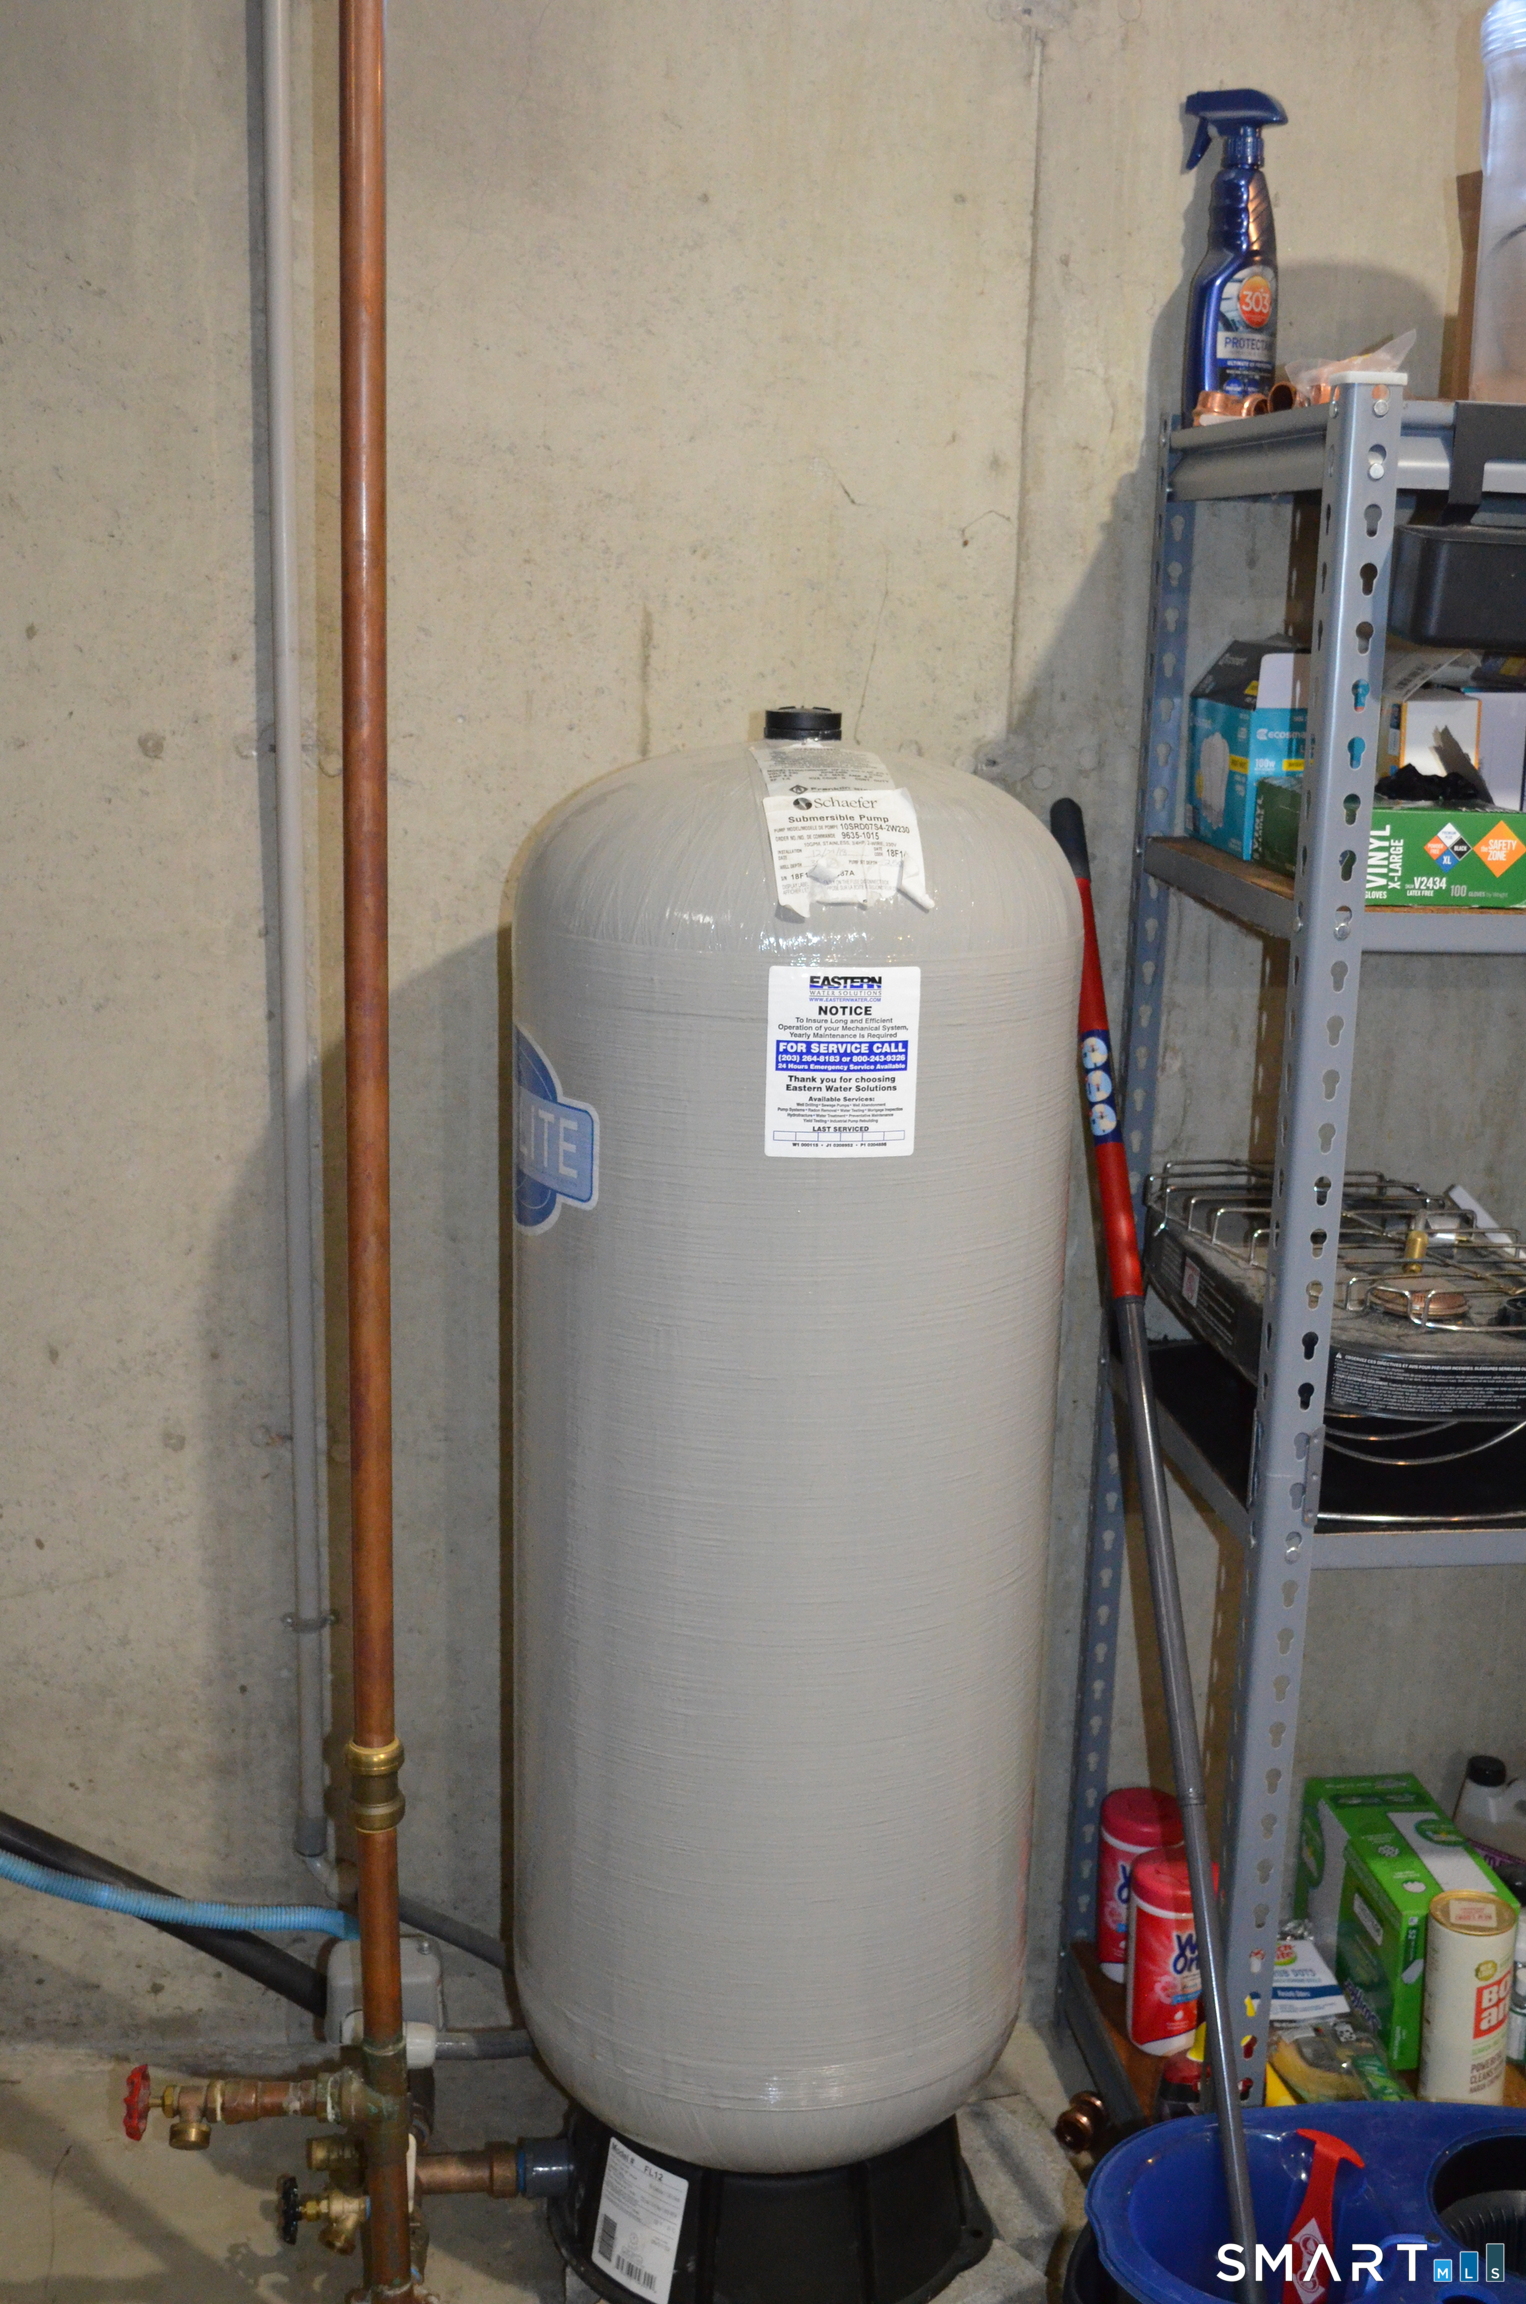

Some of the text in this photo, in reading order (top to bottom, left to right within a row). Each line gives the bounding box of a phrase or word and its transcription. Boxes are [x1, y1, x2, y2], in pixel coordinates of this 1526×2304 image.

[1242, 291, 1271, 313] 303
[814, 797, 878, 809] Schaefer
[788, 814, 889, 823] Submersible Pump
[841, 832, 880, 840] 9635-1015
[1488, 840, 1517, 851] SAFETY
[1366, 824, 1391, 889] VINYL
[1443, 856, 1452, 865] XL
[1488, 851, 1507, 861] ZONE
[1388, 839, 1404, 889] X-LARGE
[1414, 877, 1447, 890] V2434
[1451, 885, 1467, 897] 100
[809, 976, 882, 989] EASTERN
[818, 1006, 872, 1016] NOTICE
[778, 1024, 813, 1032] Operation
[779, 1042, 906, 1053] FOR SERVICE CALL
[778, 1055, 800, 1063] (203)
[802, 1055, 840, 1063] 264-8183
[788, 1075, 817, 1083] Thank
[820, 1077, 837, 1085] you
[855, 1076, 896, 1084] choosing
[786, 1084, 897, 1092] Eastern Water Solutions
[612, 2142, 629, 2161] Model
[644, 2166, 664, 2182] FL12
